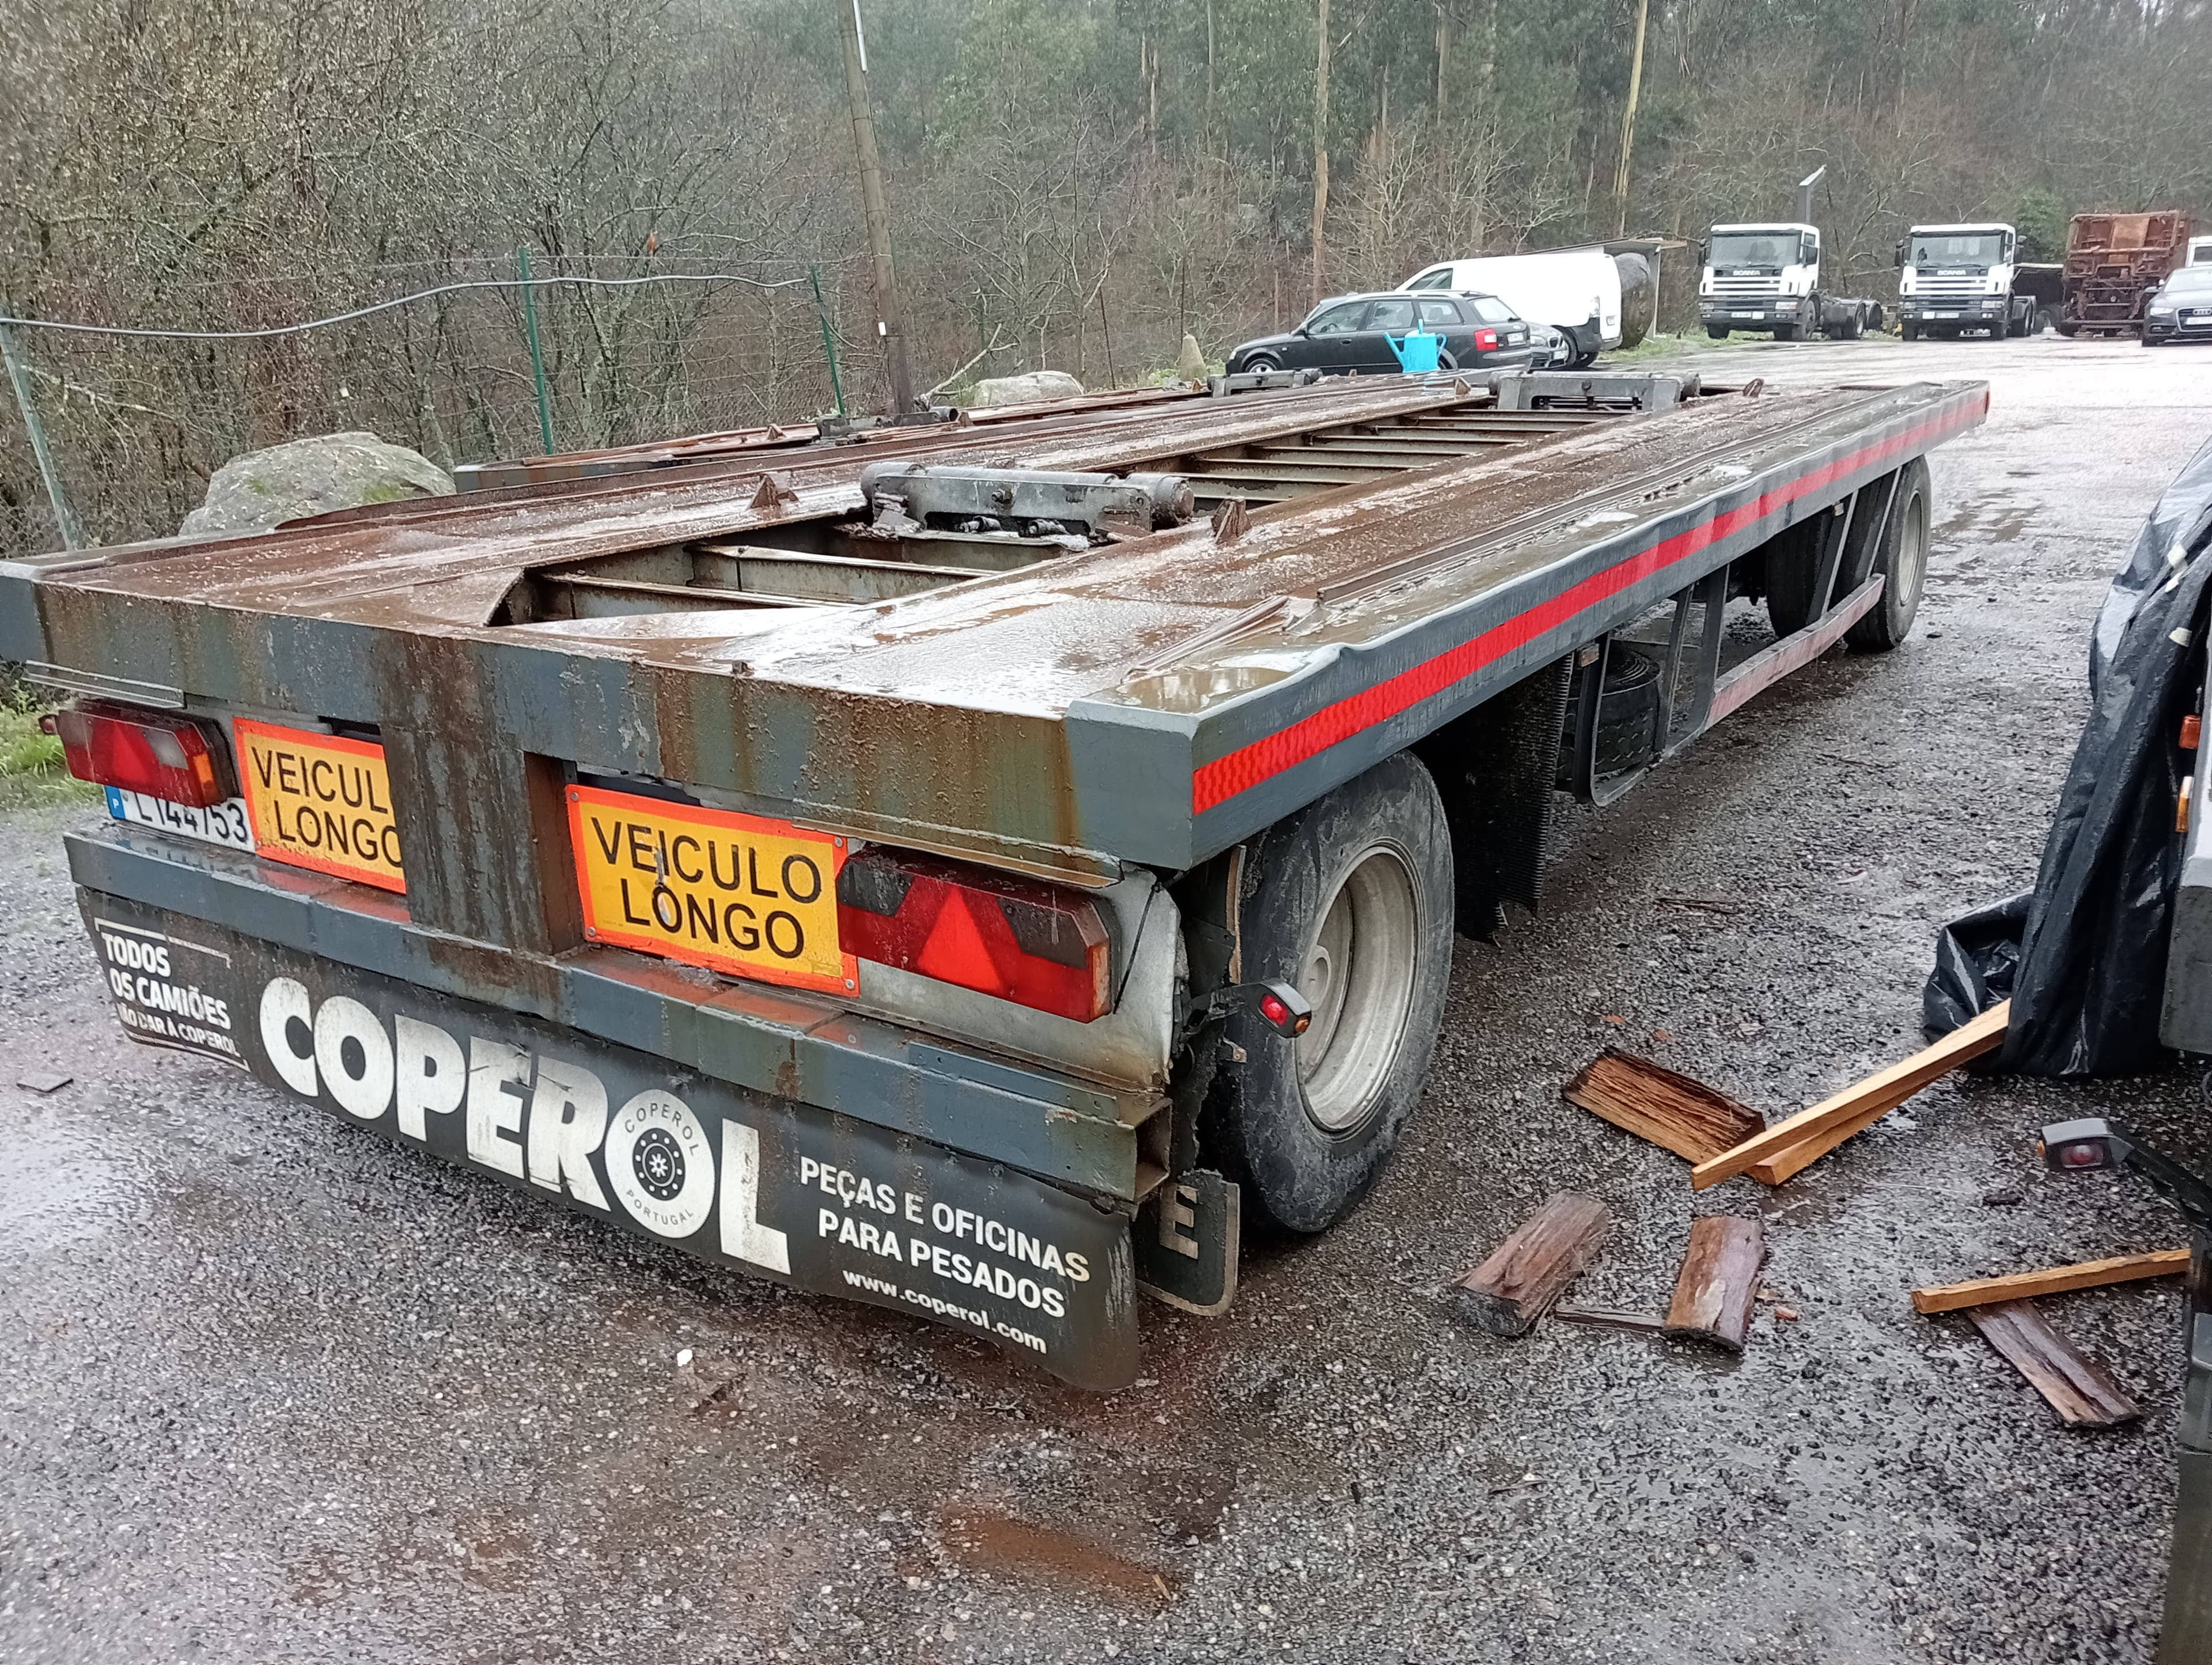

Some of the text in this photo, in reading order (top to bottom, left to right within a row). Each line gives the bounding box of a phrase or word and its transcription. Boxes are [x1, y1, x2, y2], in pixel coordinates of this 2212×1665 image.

[112, 798, 119, 809] P
[252, 746, 388, 814] VEICUL
[590, 817, 822, 904] VEICULO
[620, 878, 804, 958] LONGO
[101, 932, 171, 977] TODOS
[109, 968, 232, 1030] OS CAMIÕES
[179, 1022, 241, 1058] COPEROL
[259, 976, 791, 1276] COPEROL
[624, 1103, 699, 1156] COPEROL
[626, 1189, 694, 1225] PORTUGAL
[800, 1156, 1090, 1283] PEÇAS E OFICINAS
[819, 1208, 1066, 1318] PARA PESADOS
[842, 1269, 1047, 1354] www.coperol.com
